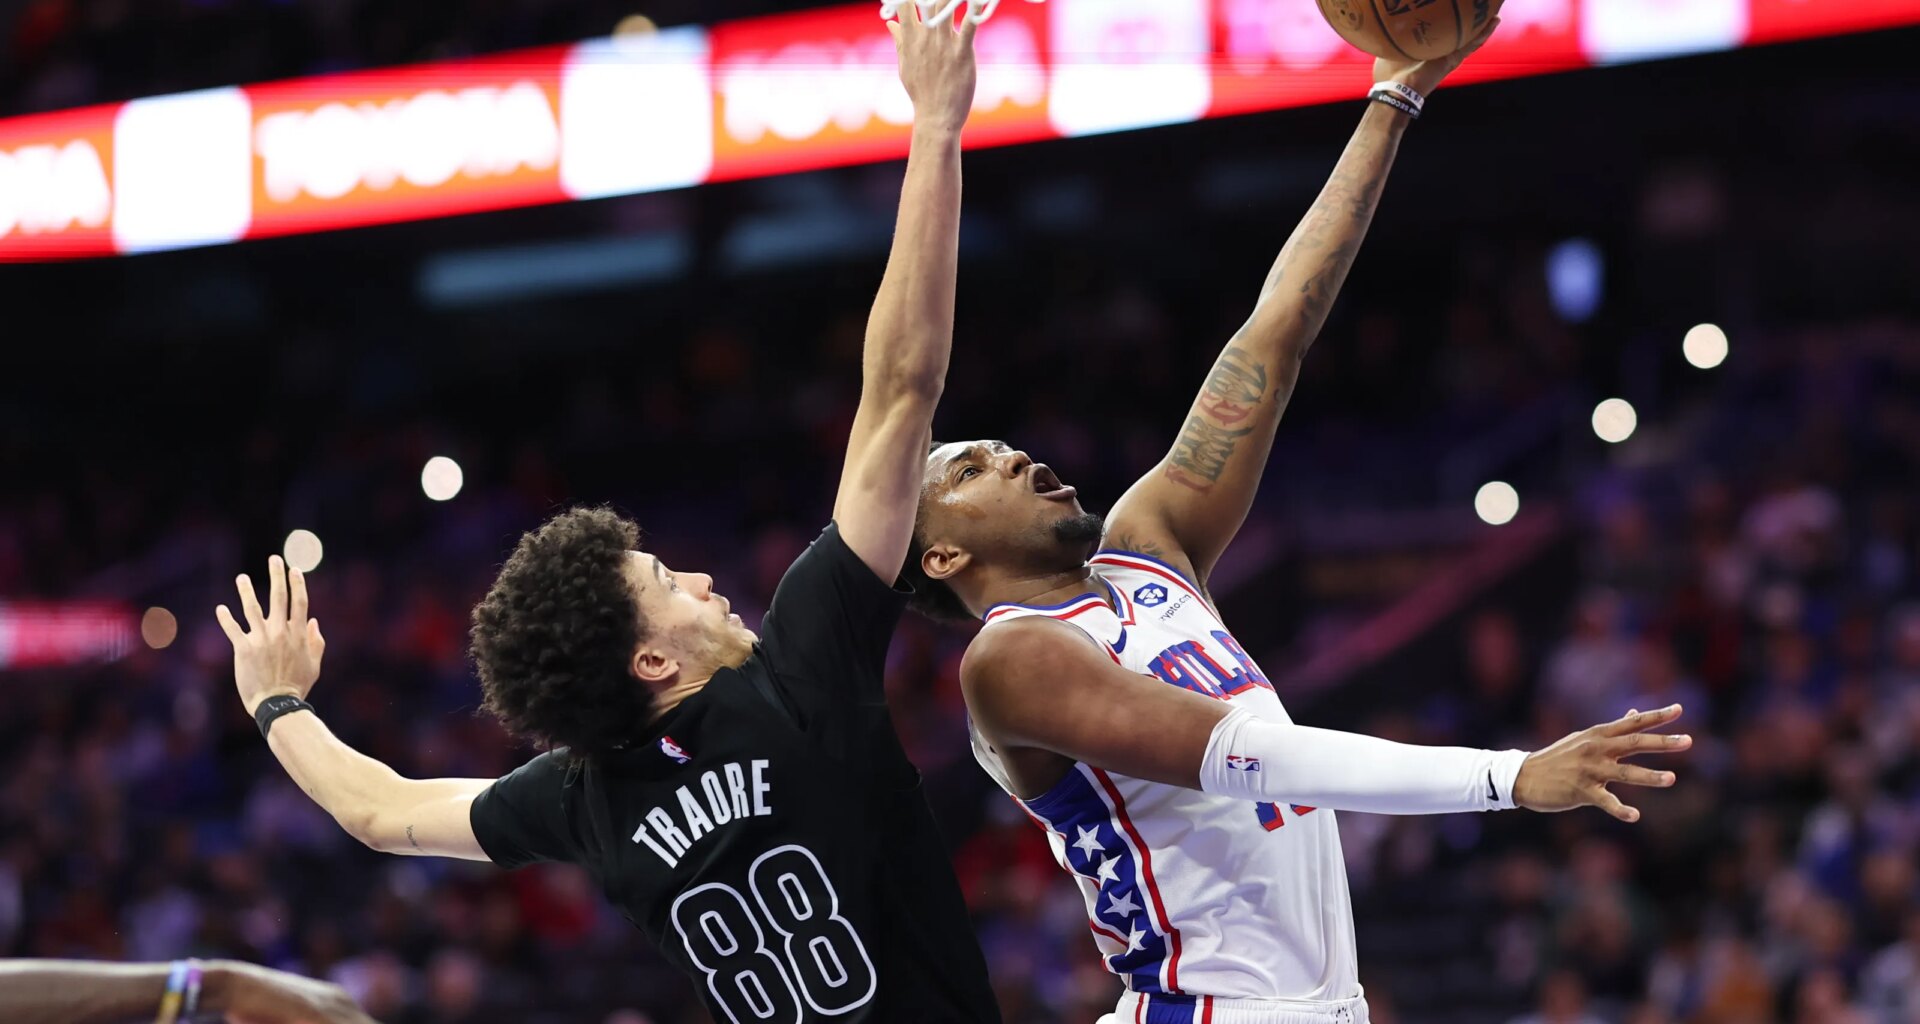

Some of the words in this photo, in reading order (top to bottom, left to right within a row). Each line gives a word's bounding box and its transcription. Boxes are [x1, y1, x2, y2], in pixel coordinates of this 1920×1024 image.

[0, 138, 111, 237] TA
[632, 759, 772, 868] TRAORE
[670, 844, 877, 1024] 88
